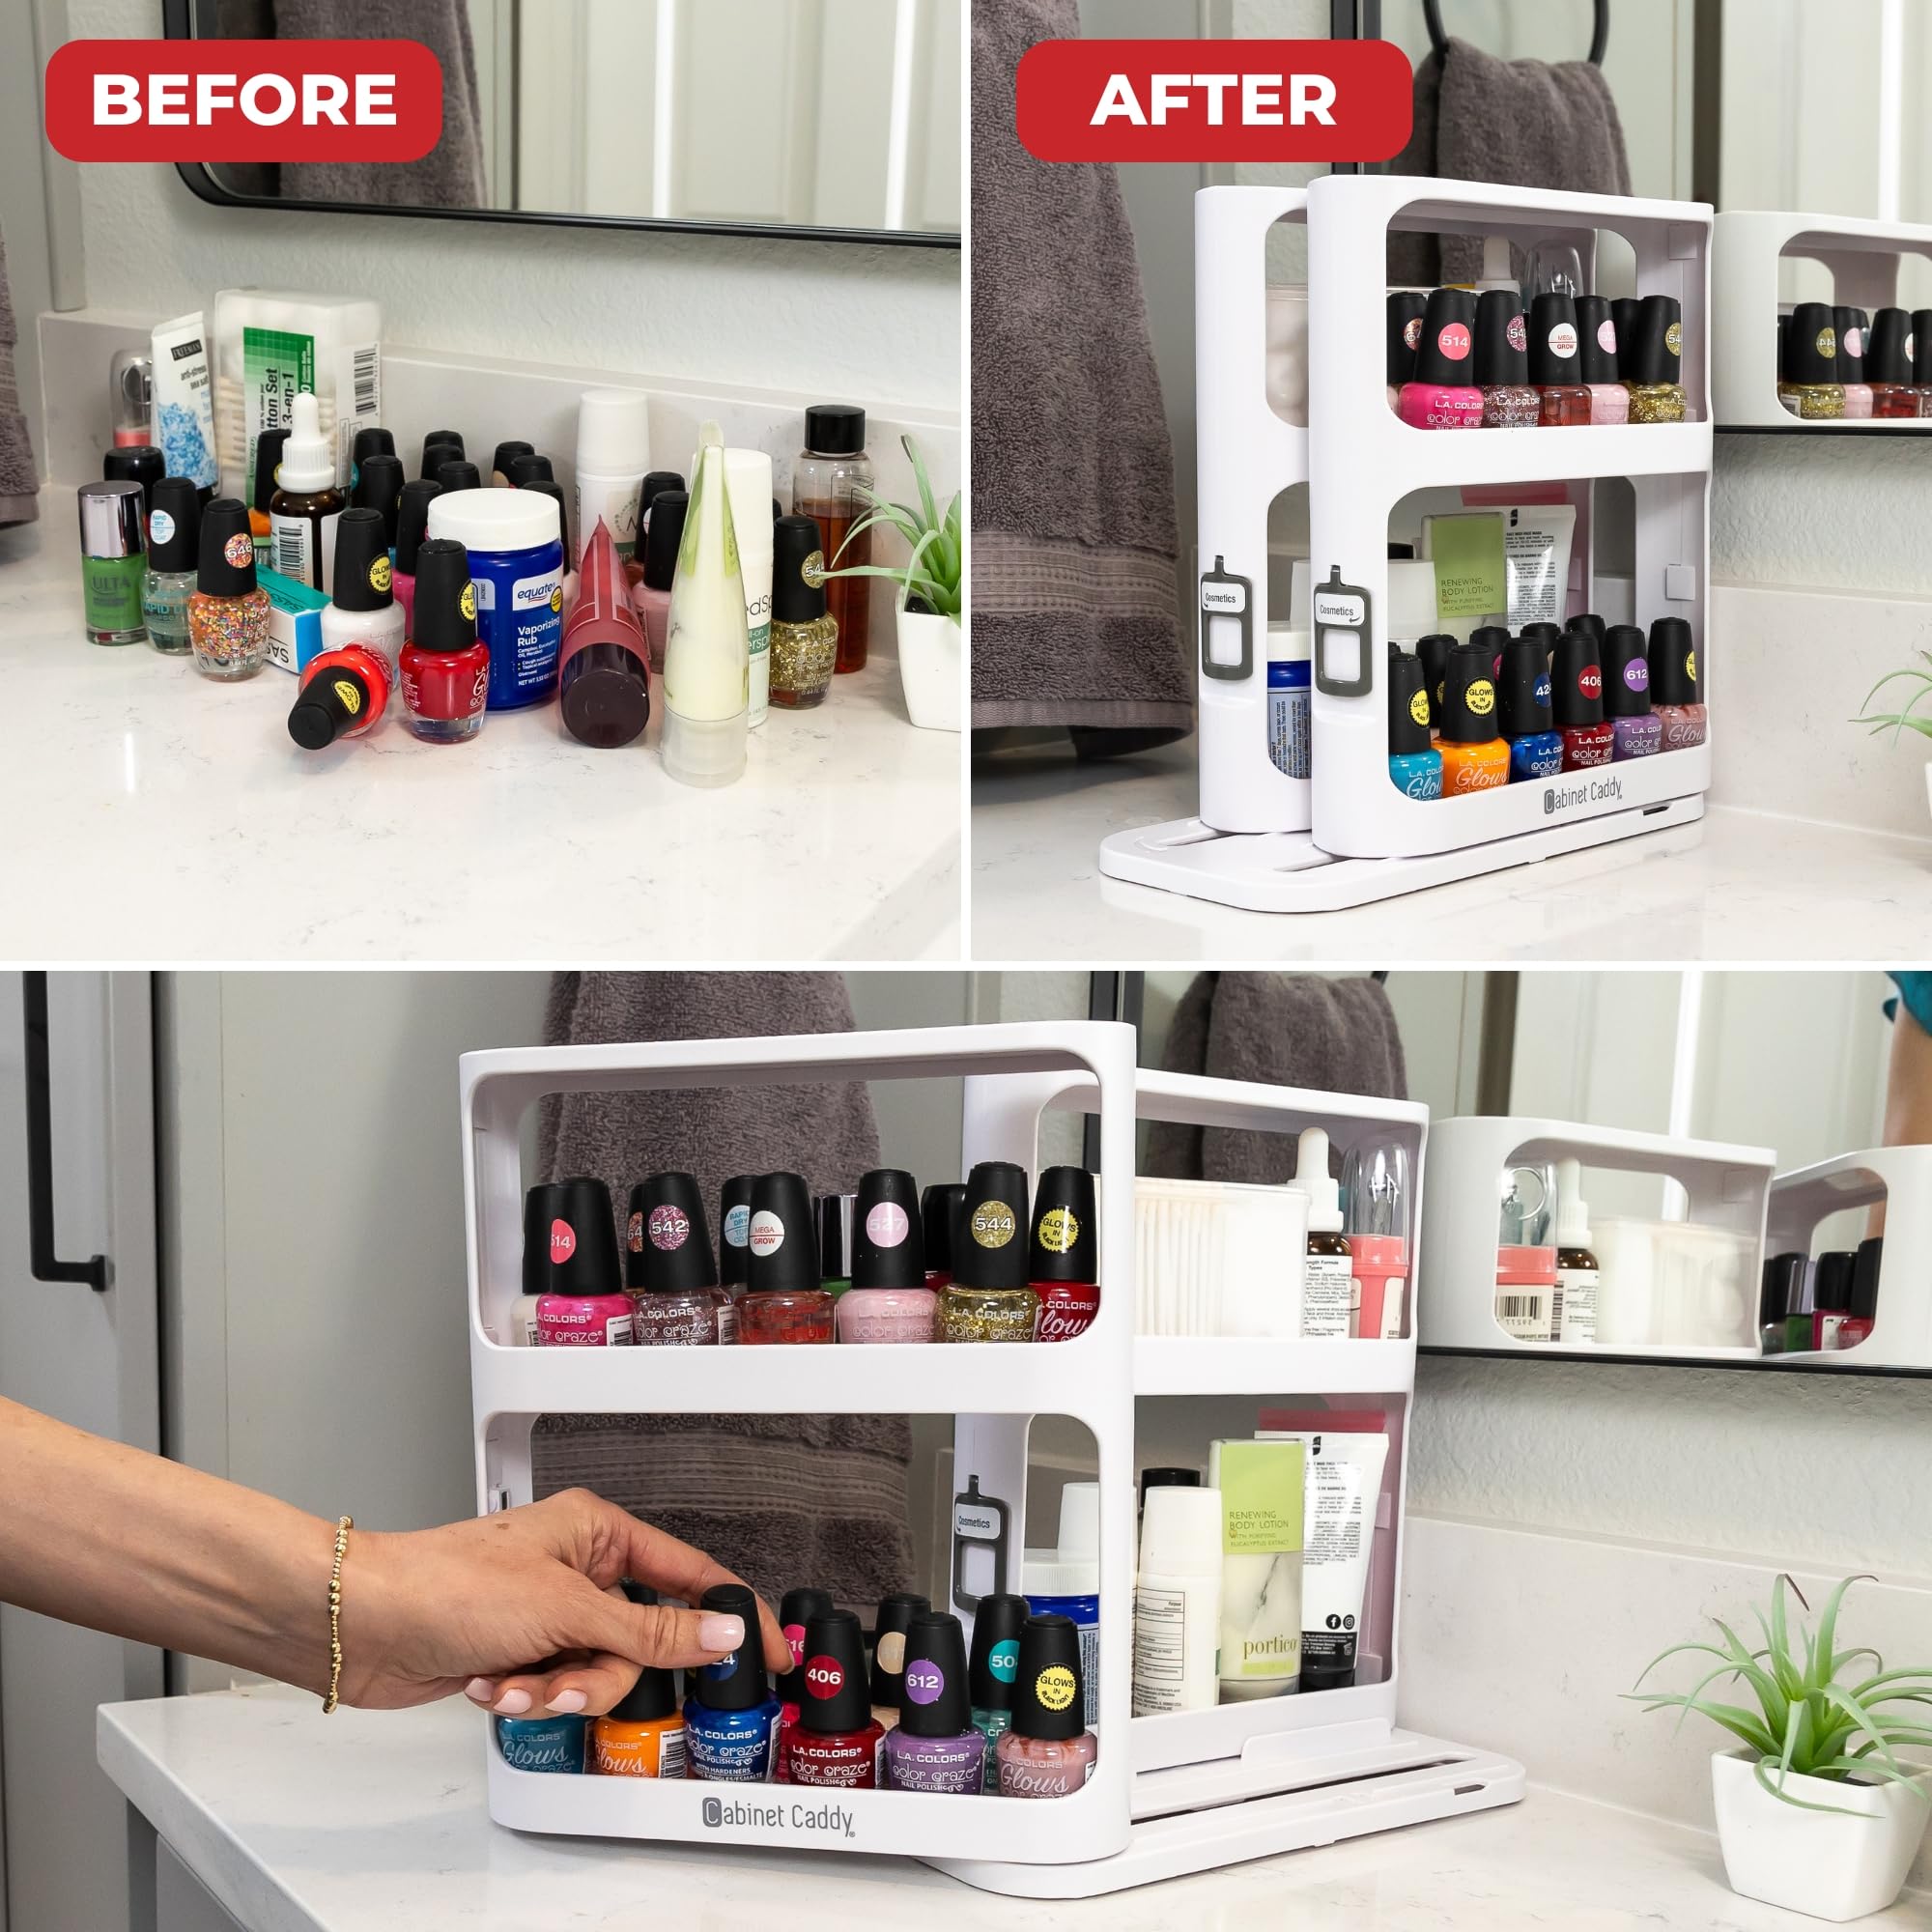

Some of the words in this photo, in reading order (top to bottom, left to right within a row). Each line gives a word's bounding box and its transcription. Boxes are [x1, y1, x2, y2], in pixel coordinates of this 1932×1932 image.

[1510, 328, 1526, 338] 54
[1669, 334, 1681, 343] 54
[1441, 335, 1468, 347] 514
[266, 368, 278, 393] Set
[266, 398, 278, 428] tton
[226, 543, 252, 558] 646
[372, 564, 391, 576] GLOW
[806, 565, 823, 577] 54
[1441, 577, 1483, 587] RENEWING
[518, 583, 554, 600] equate
[1441, 587, 1465, 596] BODY
[1468, 585, 1493, 594] LOTION
[1205, 592, 1236, 604] Cosmetics
[144, 602, 170, 614] APID
[1320, 604, 1354, 616] Cosmetics
[518, 616, 560, 636] Vaporizing
[517, 636, 538, 647] Rub
[1626, 669, 1647, 679] 612
[1581, 676, 1602, 686] 406
[1413, 699, 1428, 708] GLOW
[1596, 733, 1614, 744] COLOR
[1668, 725, 1705, 743] Glow
[1544, 785, 1587, 814] Cabinet
[1591, 777, 1622, 801] Caddy
[652, 1220, 688, 1234] 542
[870, 1217, 906, 1230] 527
[975, 1217, 1013, 1231] 544
[628, 1227, 642, 1240] 64
[1046, 1297, 1094, 1311] COLORS
[543, 1315, 587, 1324] COLORS
[647, 1308, 696, 1319] COLORS
[953, 1307, 971, 1317] L.A.
[976, 1309, 1025, 1321] COLORS
[1230, 1511, 1277, 1520] RENEWING
[958, 1516, 990, 1529] Cosmetics
[1230, 1521, 1255, 1530] BODY
[1260, 1520, 1289, 1528] LOTION
[1244, 1634, 1297, 1661] portico
[991, 1656, 1018, 1668] 50
[808, 1668, 841, 1685] 406
[907, 1673, 939, 1689] 612
[1040, 1675, 1074, 1689] GLOWS
[1041, 1690, 1056, 1704] BLACK
[1055, 1694, 1069, 1705] LIGHT
[517, 1732, 561, 1742] COLORS
[687, 1724, 704, 1737] L.A.
[704, 1730, 753, 1740] COLORS
[793, 1745, 808, 1756] L.A.
[809, 1748, 858, 1758] COLORS
[896, 1750, 915, 1761] L.A.
[917, 1753, 966, 1764] COLORS
[706, 1756, 731, 1765] POLISH
[1016, 1760, 1064, 1769] COLORS
[710, 1766, 751, 1775] HARDENERS
[810, 1776, 836, 1785] POLISH
[1001, 1763, 1069, 1792] Glows
[900, 1780, 915, 1789] NAIL
[916, 1782, 943, 1791] POLISH
[702, 1797, 784, 1829] Cabinet
[791, 1804, 853, 1837] Caddy
